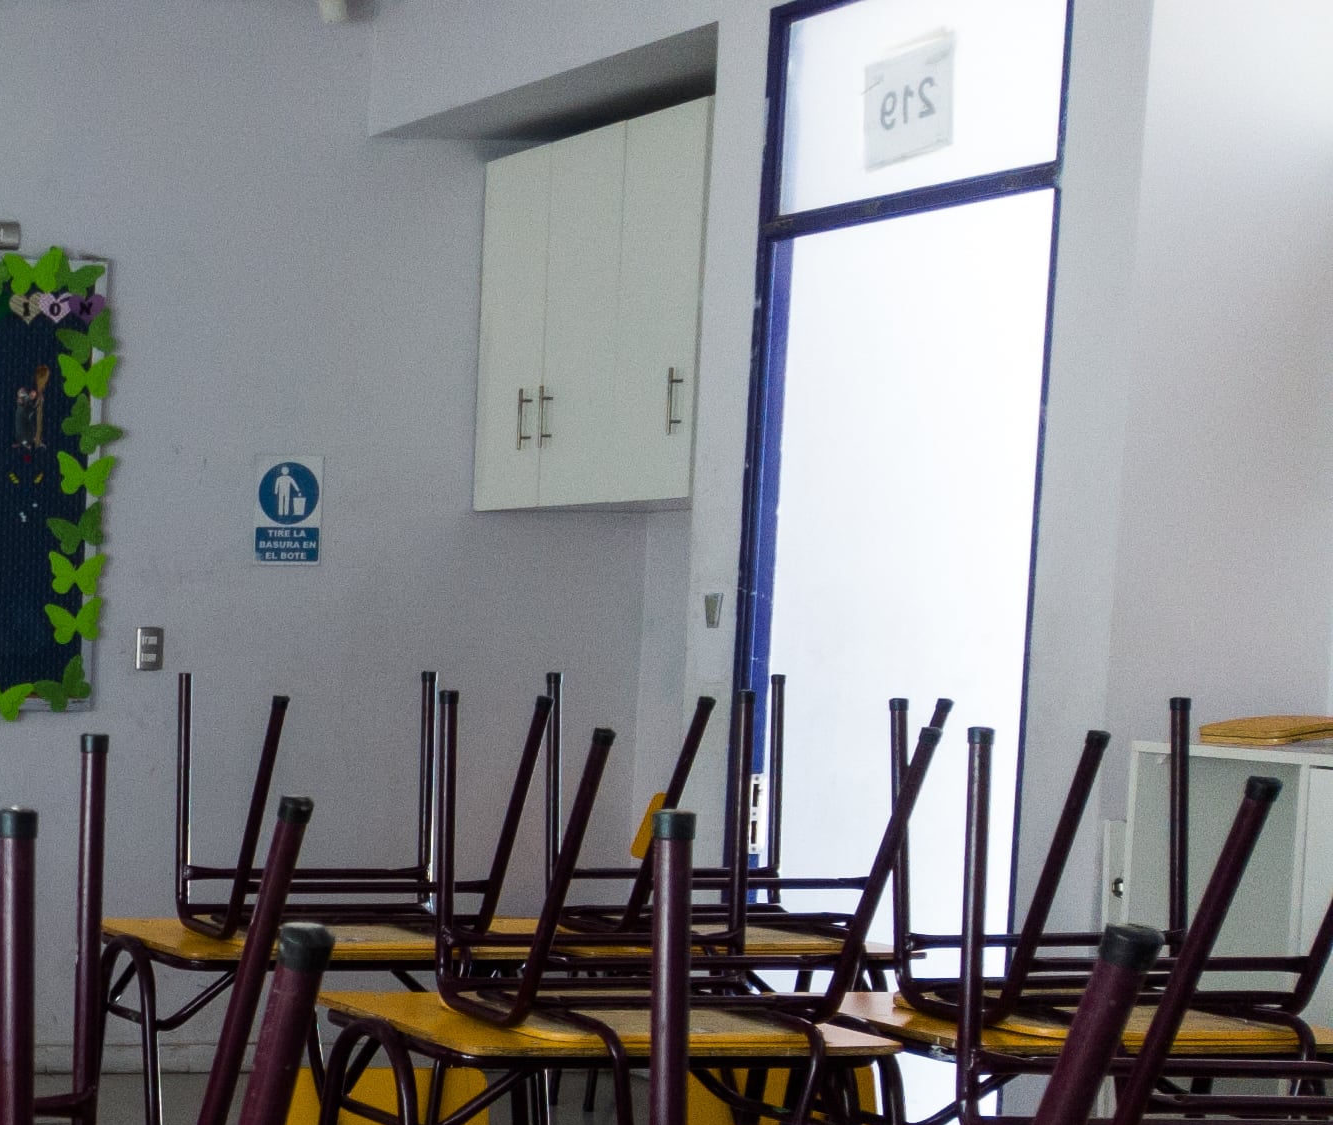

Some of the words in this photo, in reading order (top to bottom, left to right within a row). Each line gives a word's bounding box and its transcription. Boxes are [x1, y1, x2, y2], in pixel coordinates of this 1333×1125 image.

[267, 529, 291, 538] TIRE
[293, 529, 307, 538] LA
[259, 540, 300, 549] BASURA
[302, 540, 317, 549] EN
[265, 552, 278, 560] EL
[280, 552, 307, 560] BOTE
